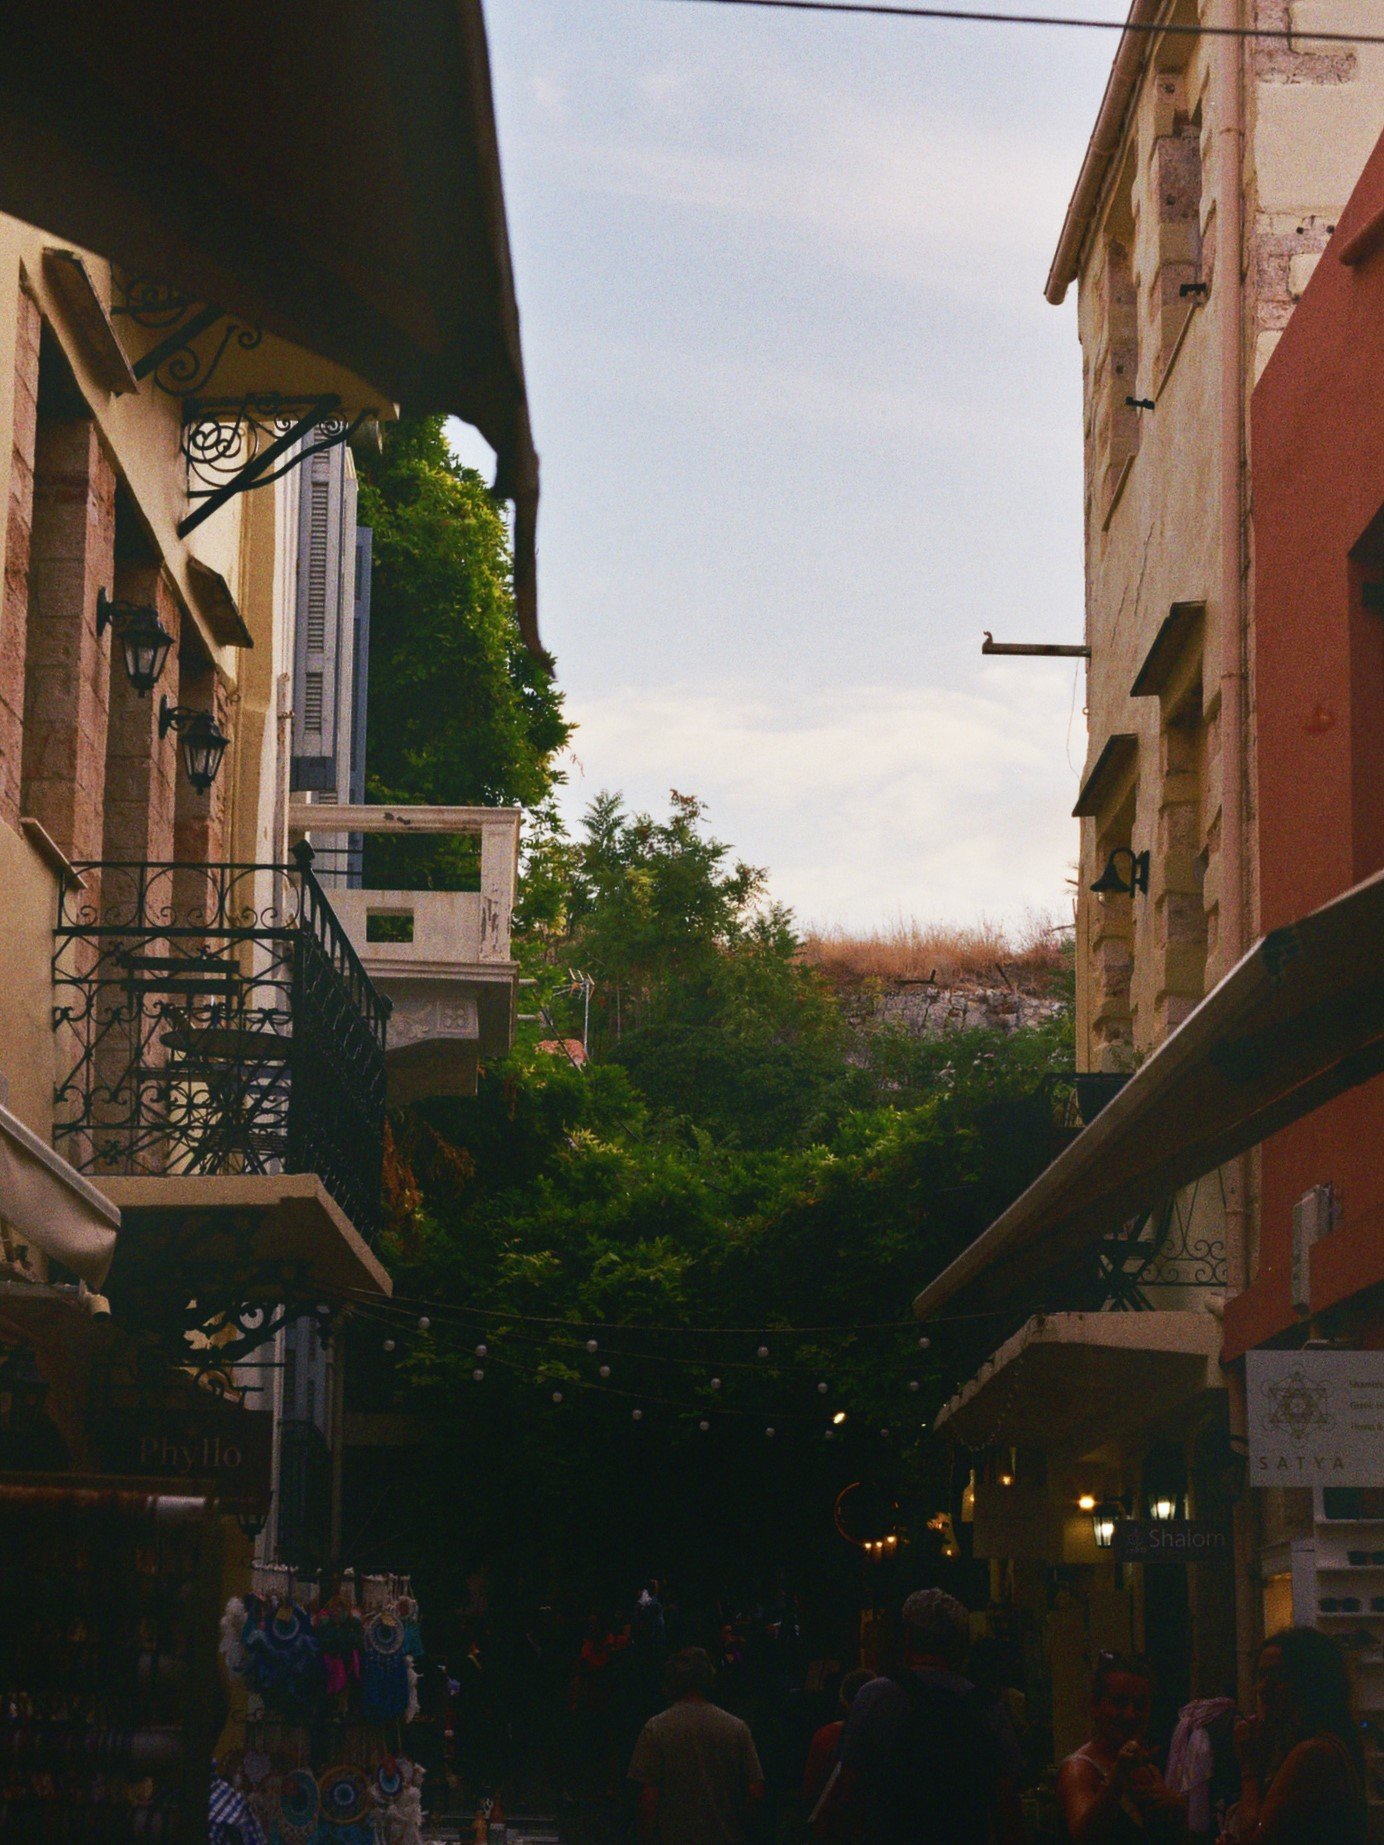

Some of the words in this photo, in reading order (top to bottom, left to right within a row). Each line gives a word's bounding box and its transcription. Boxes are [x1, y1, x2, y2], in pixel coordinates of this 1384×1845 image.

[140, 1435, 242, 1474] Phyllo
[1259, 1456, 1344, 1470] SATYA
[1149, 1528, 1225, 1548] Shalom
